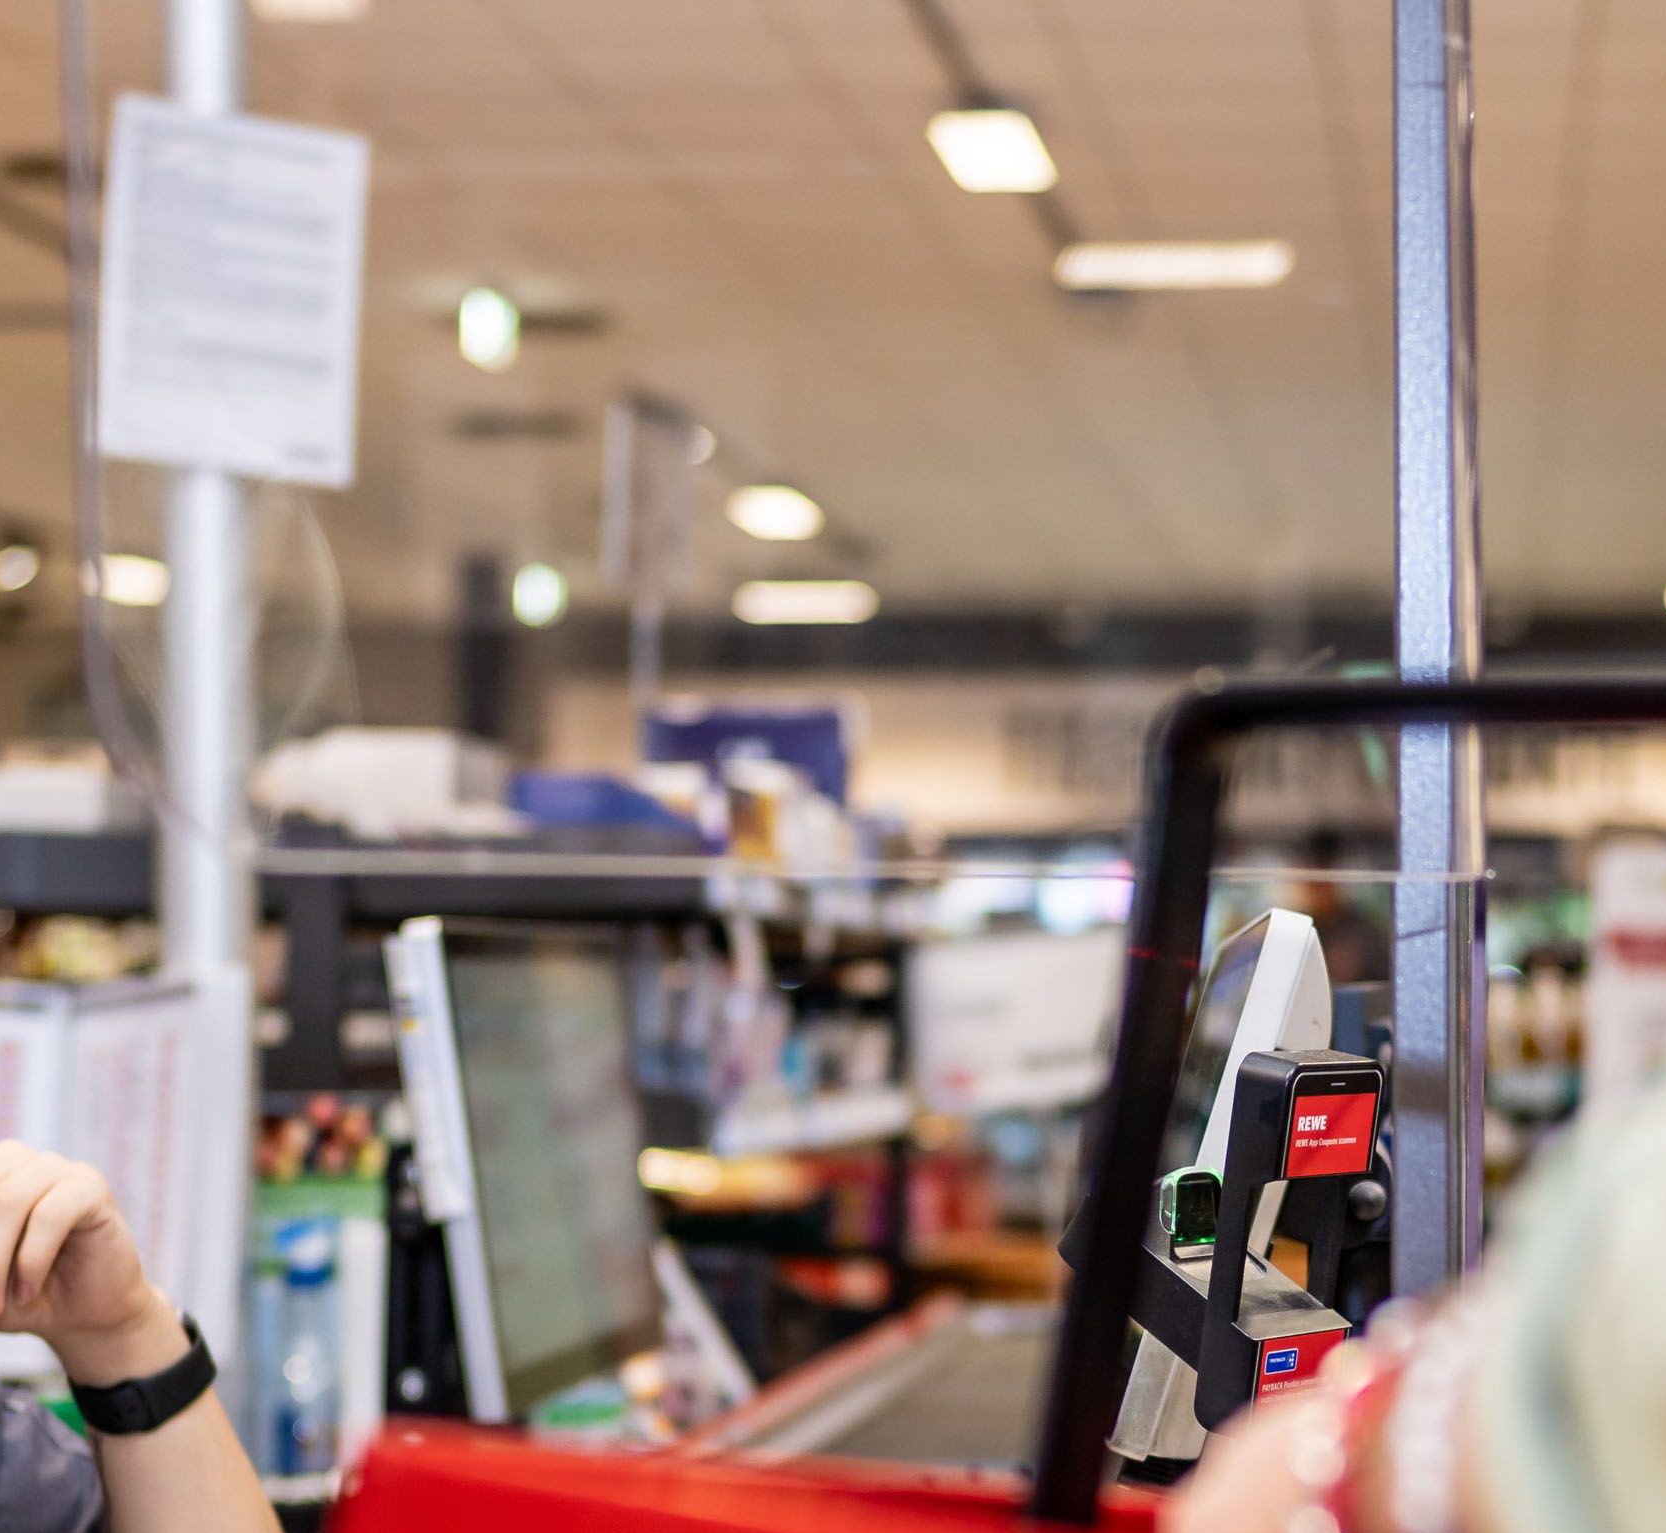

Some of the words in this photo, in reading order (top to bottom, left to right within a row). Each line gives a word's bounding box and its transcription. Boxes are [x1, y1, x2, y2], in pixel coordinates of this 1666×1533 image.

[1297, 1115, 1328, 1132] REWE
[1295, 1139, 1309, 1149] REWE
[1309, 1139, 1319, 1148] App
[1319, 1137, 1338, 1147] Coupons
[1338, 1136, 1357, 1145] scannen
[1262, 1382, 1283, 1393] PAYBACK
